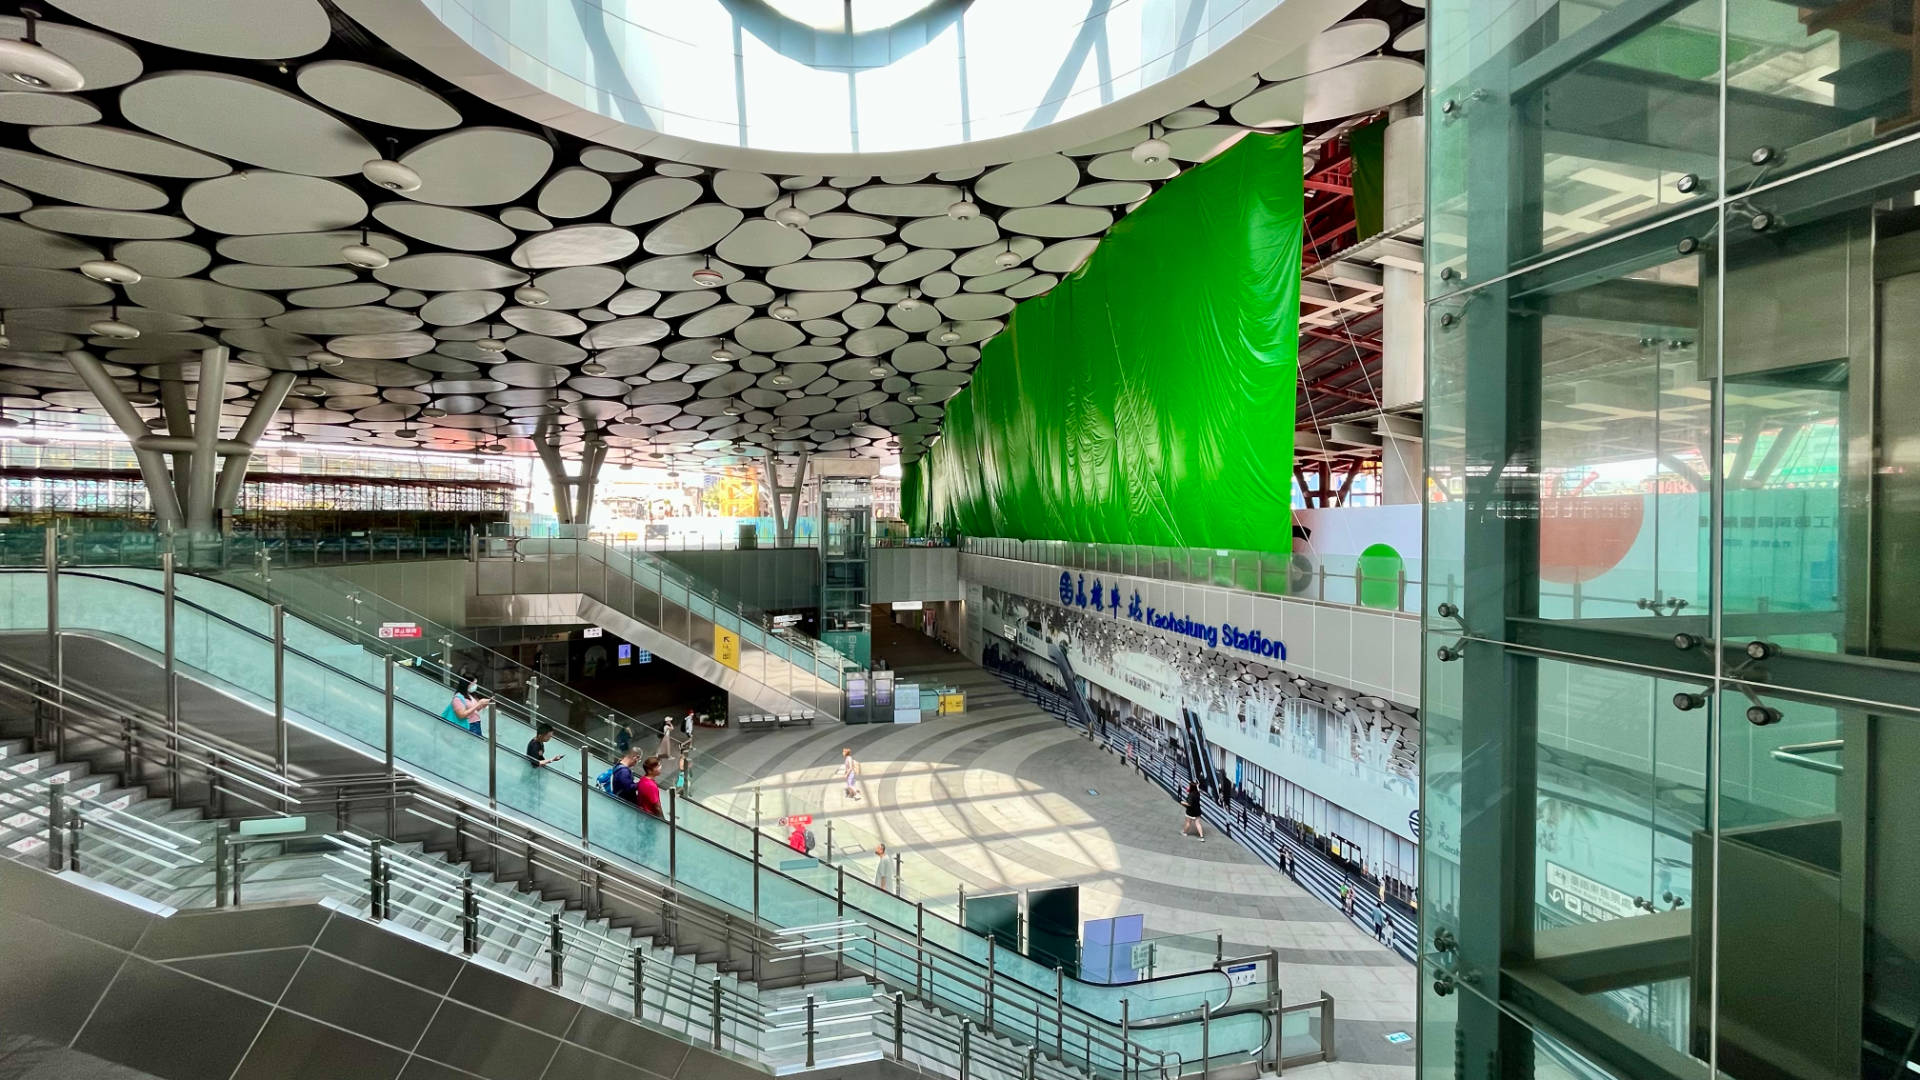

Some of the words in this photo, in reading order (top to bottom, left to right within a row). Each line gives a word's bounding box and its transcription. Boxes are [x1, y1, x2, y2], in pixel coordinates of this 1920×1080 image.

[1075, 573, 1143, 622] 高雄車站
[1146, 607, 1218, 648] Kaohsiung
[1221, 623, 1288, 661] Station
